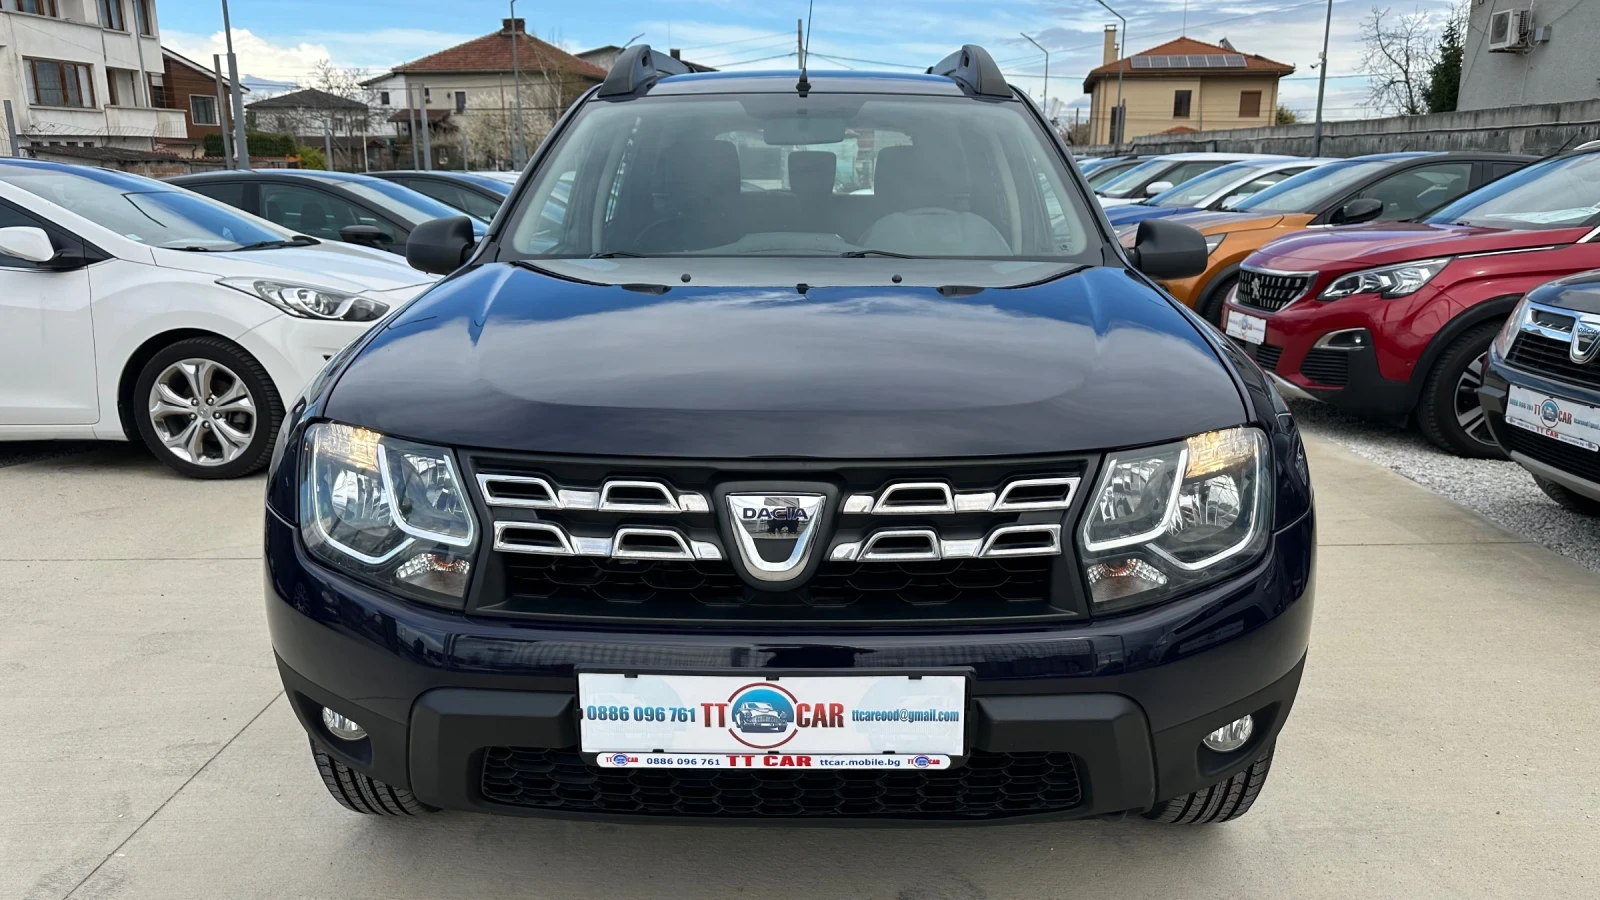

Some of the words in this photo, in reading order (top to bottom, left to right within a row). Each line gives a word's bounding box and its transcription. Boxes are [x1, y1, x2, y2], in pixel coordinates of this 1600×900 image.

[1558, 410, 1572, 425] CAR
[1535, 425, 1544, 434] TT
[1545, 428, 1559, 439] CAR
[743, 506, 808, 520] DACIA
[586, 705, 630, 722] 0886
[633, 706, 666, 722] 096
[669, 706, 696, 723] 761
[701, 702, 729, 728] TT
[796, 702, 845, 728] CAR
[852, 708, 959, 723] ttcareood@gmail.com
[646, 757, 673, 765] 0886
[677, 757, 697, 766] 096
[701, 758, 720, 766] 761
[726, 755, 755, 767] TT
[763, 755, 812, 767] CAR
[820, 758, 901, 767] ttcar.mobile.bg
